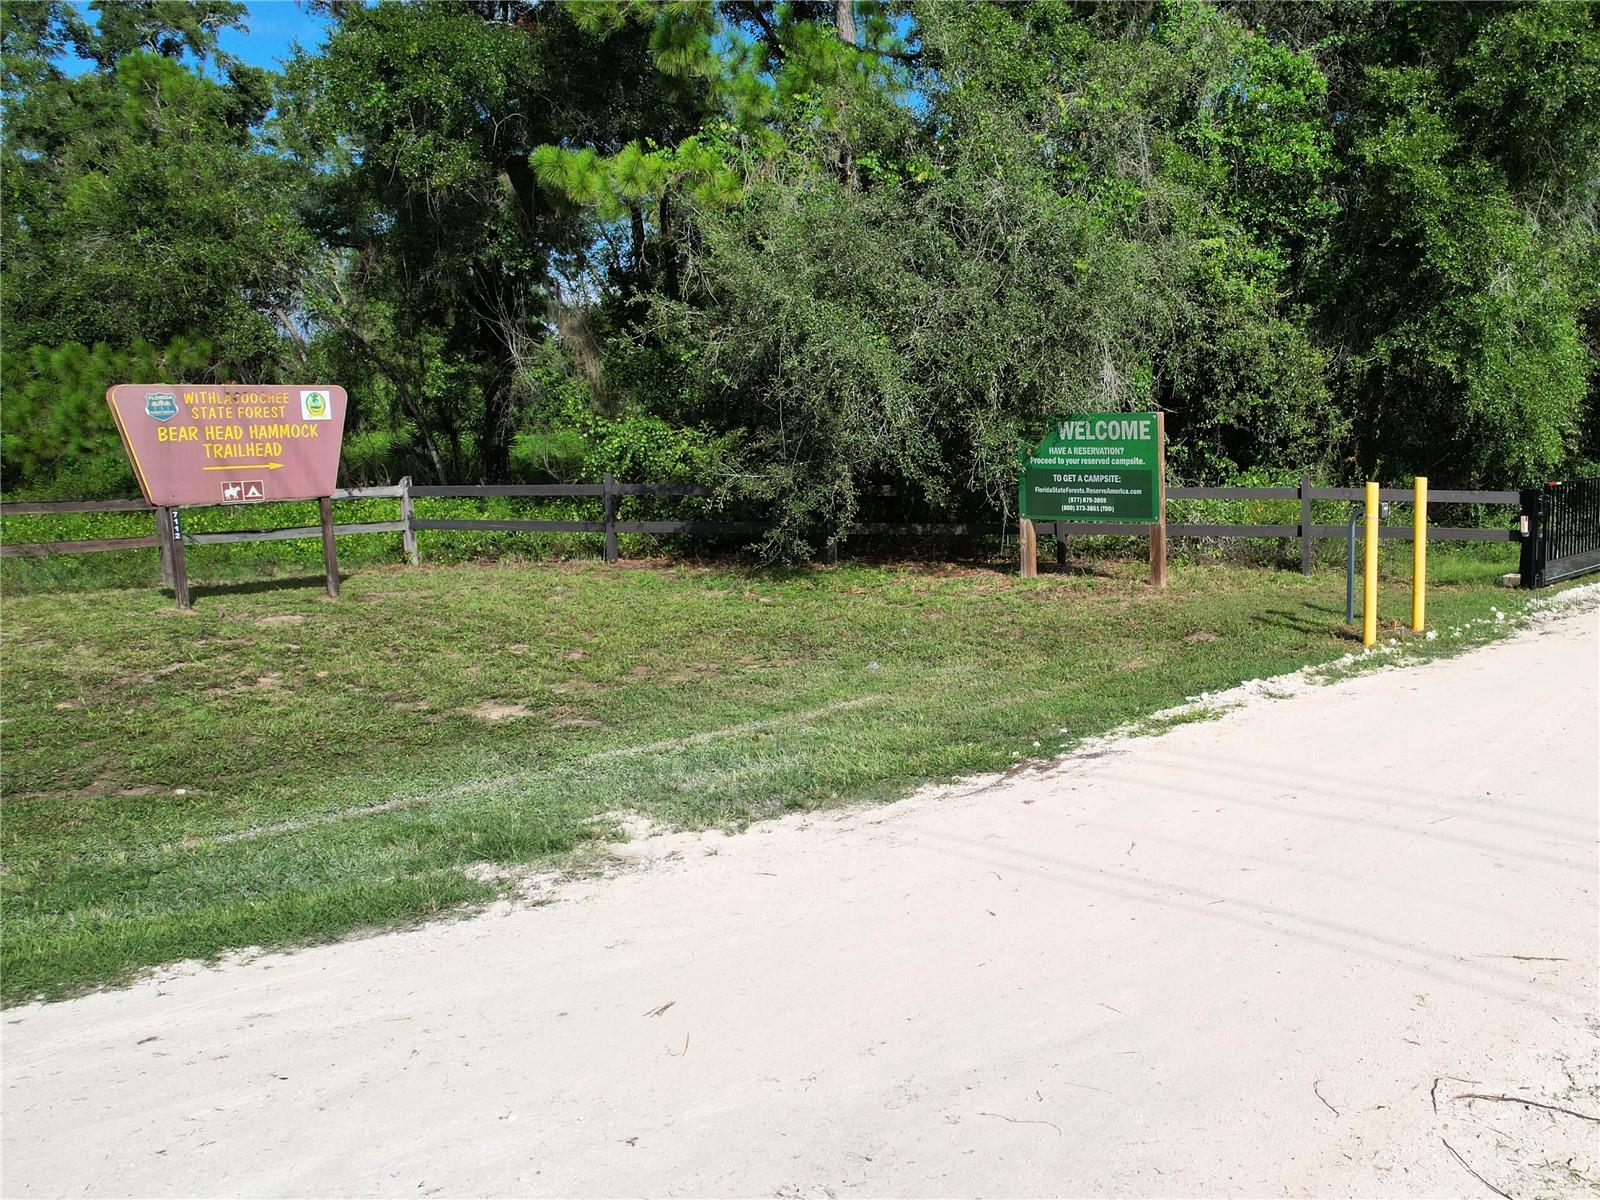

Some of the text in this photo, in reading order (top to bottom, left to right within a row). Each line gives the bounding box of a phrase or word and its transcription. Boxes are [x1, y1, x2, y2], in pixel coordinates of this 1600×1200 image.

[183, 391, 289, 405] WITHLACOOCHEE
[191, 406, 286, 420] STATE FOREST
[157, 424, 319, 442] BEAR HEAD HAMMOCK
[1058, 420, 1151, 440] WELCOME
[203, 443, 282, 459] TRAILHEAD
[1048, 447, 1125, 455] HAVE A RESERVATION?
[1058, 457, 1064, 465] to
[1065, 458, 1080, 466] your
[1081, 457, 1110, 465] reserved
[1111, 457, 1146, 467] campsite.
[1053, 474, 1062, 482] TO
[1063, 474, 1077, 482] GET
[1083, 474, 1121, 483] CAMPSITE:
[1034, 486, 1142, 495] FloridaStateForests.ReserveAmerica.com
[172, 511, 181, 539] 7112
